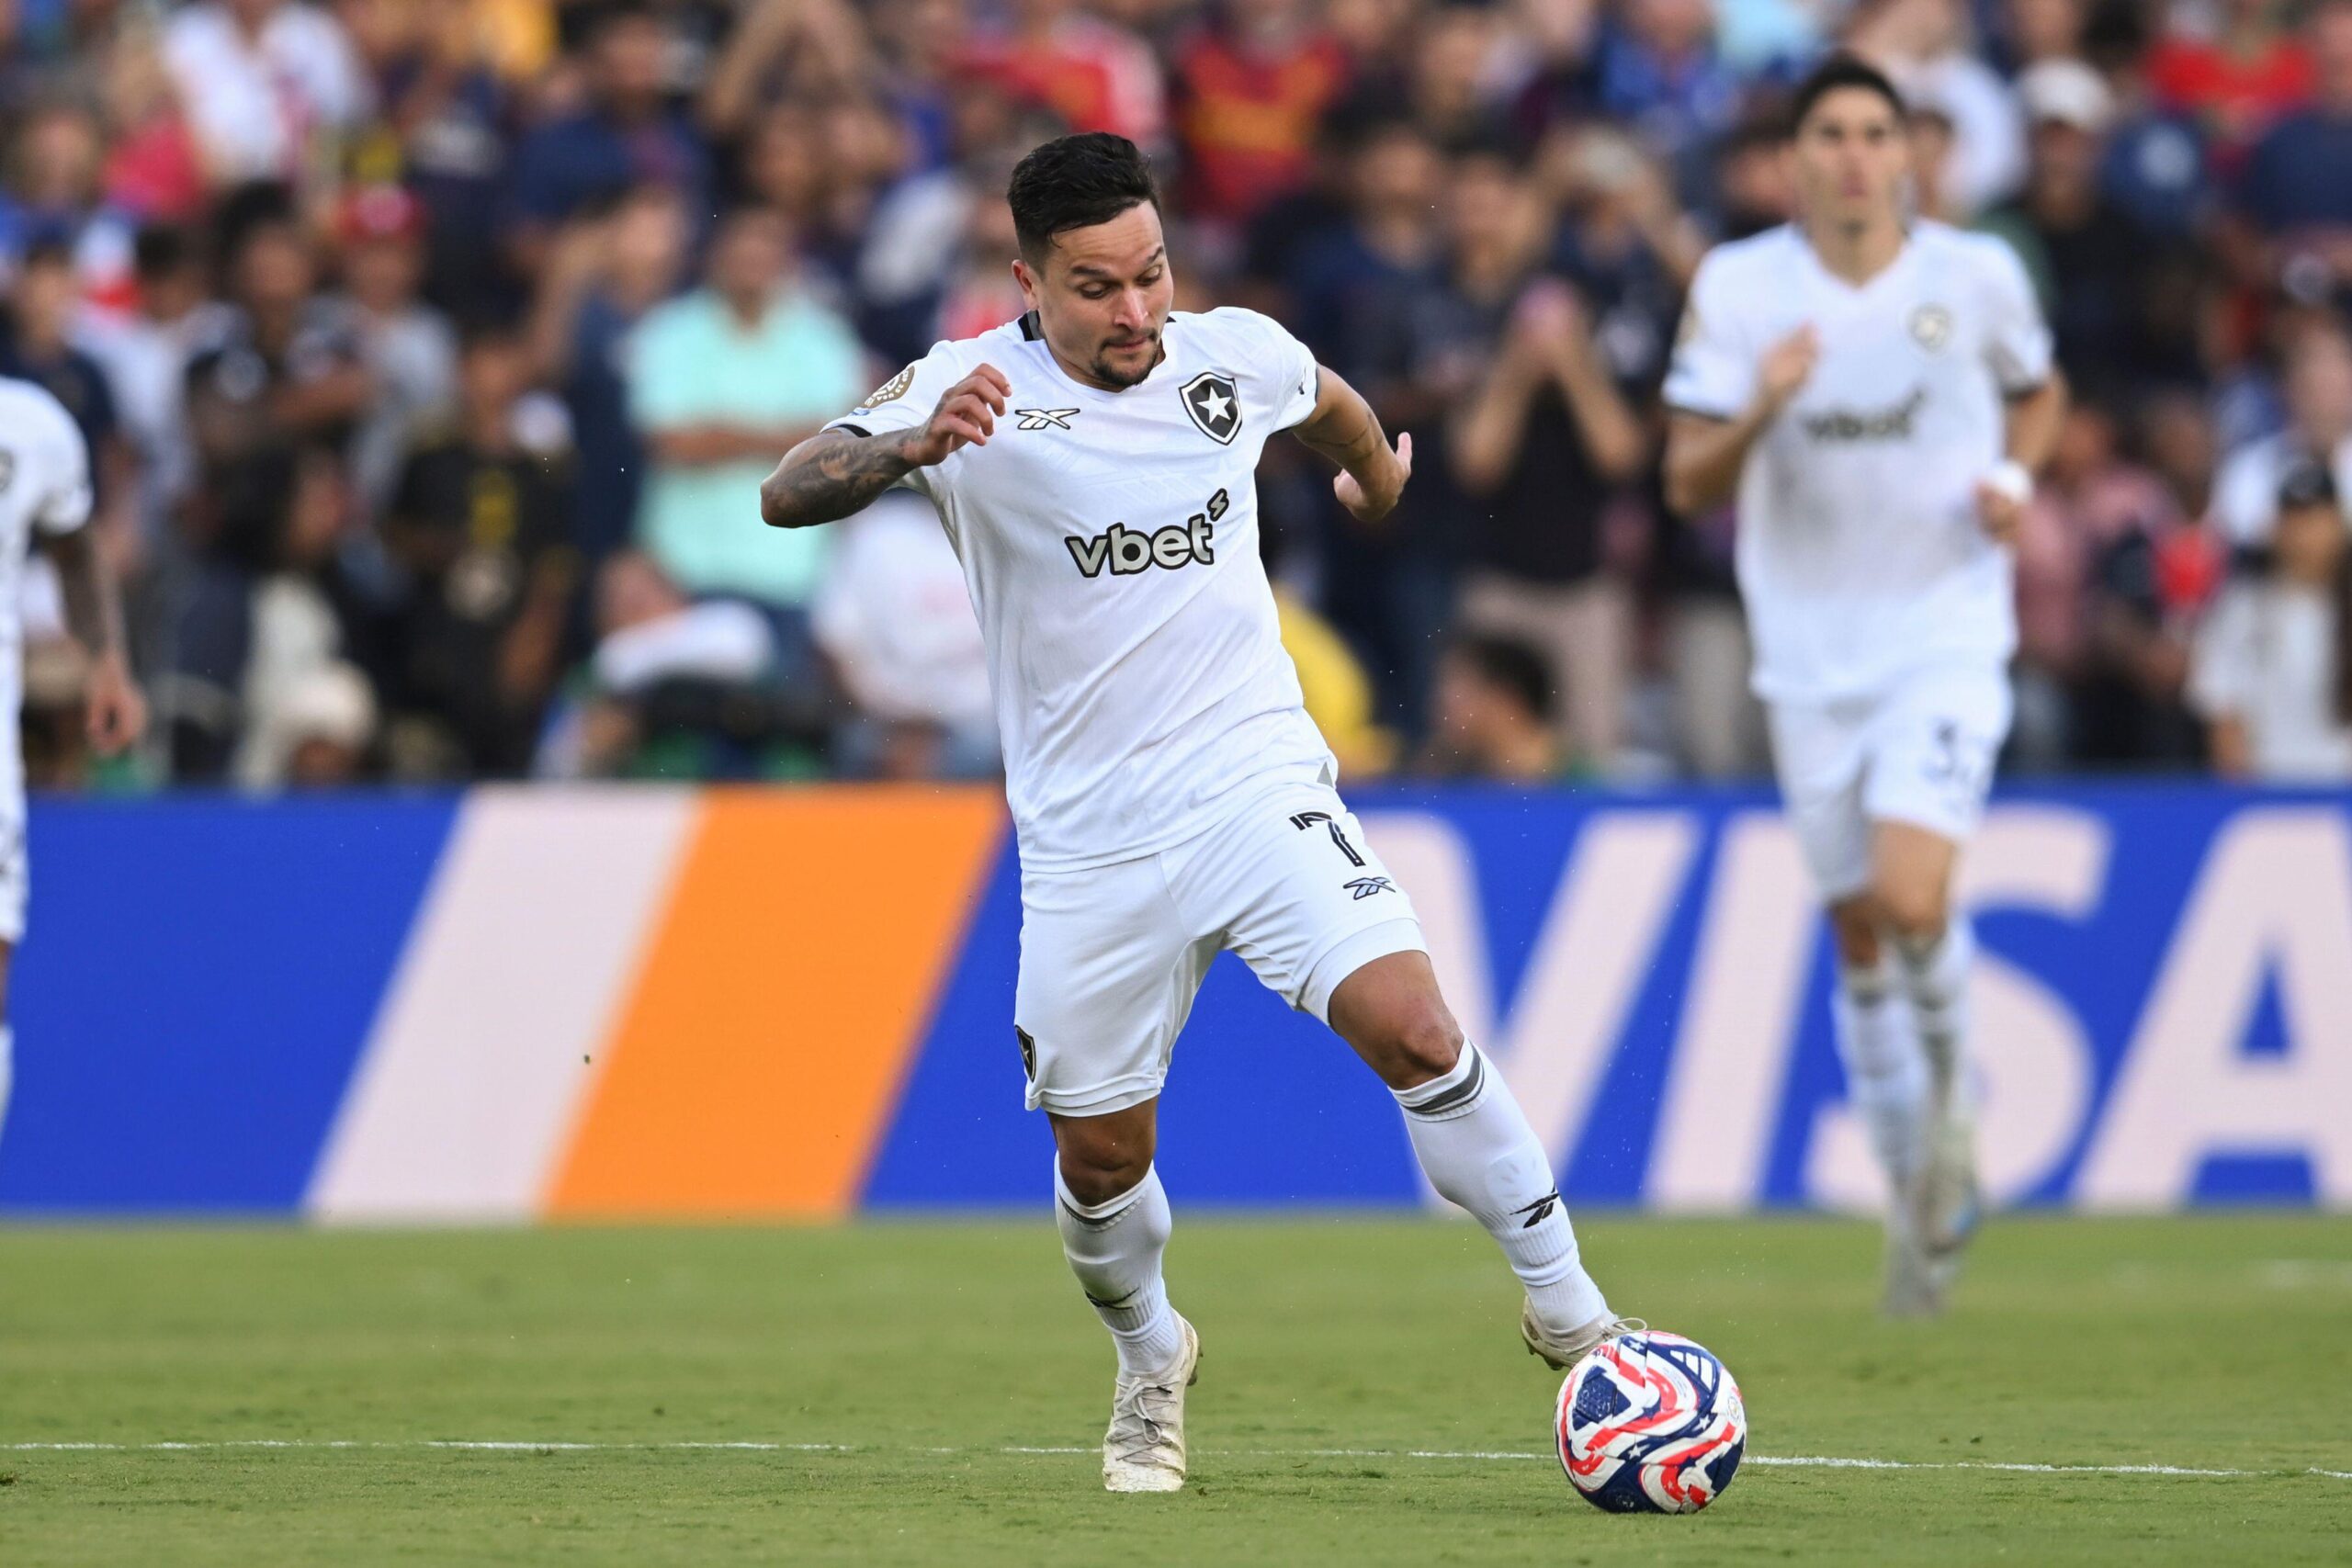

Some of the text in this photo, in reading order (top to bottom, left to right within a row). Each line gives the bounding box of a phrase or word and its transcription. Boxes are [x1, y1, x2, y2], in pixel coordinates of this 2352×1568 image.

[1064, 512, 1215, 579] vbet
[1289, 811, 1366, 867] 7
[1362, 808, 2352, 1213] VISA
